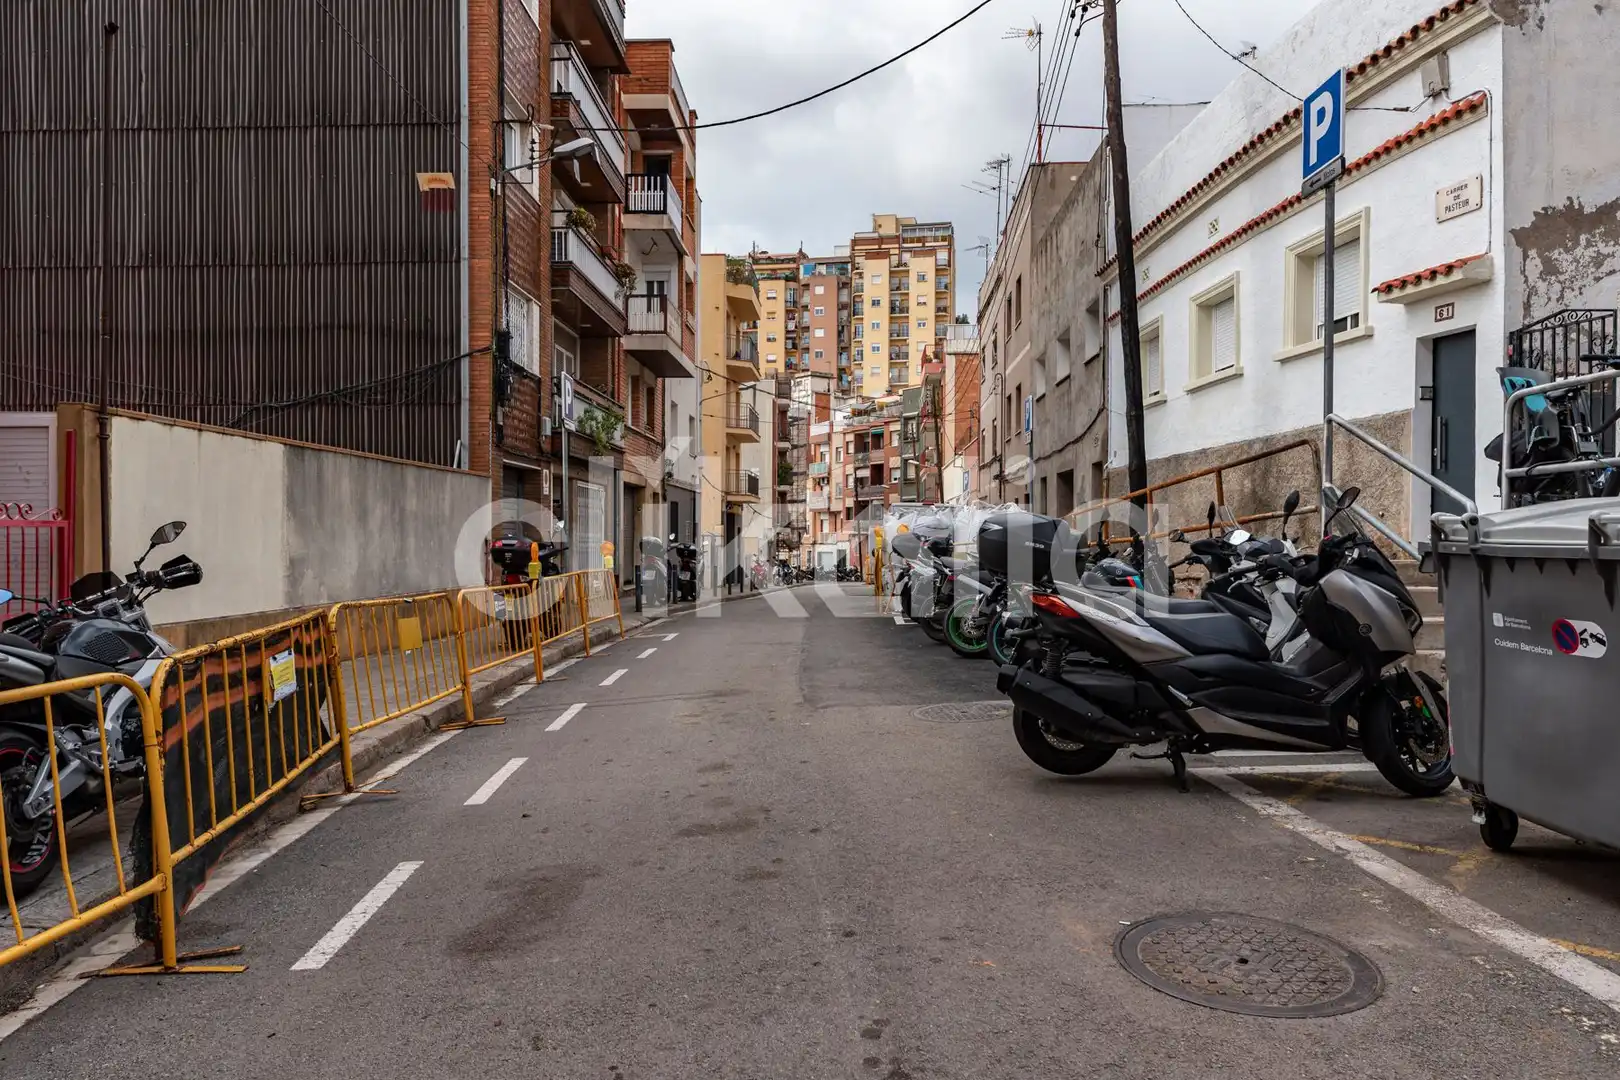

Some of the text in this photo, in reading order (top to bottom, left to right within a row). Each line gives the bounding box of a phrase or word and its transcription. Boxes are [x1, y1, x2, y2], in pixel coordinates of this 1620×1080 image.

[1309, 91, 1334, 167] P
[1445, 183, 1469, 196] CARRER
[1444, 198, 1470, 214] PASTEUR
[1438, 307, 1451, 318] 61
[565, 379, 572, 415] P
[1494, 638, 1553, 656] Cuidem Barcelona
[22, 817, 53, 864] SUZU
